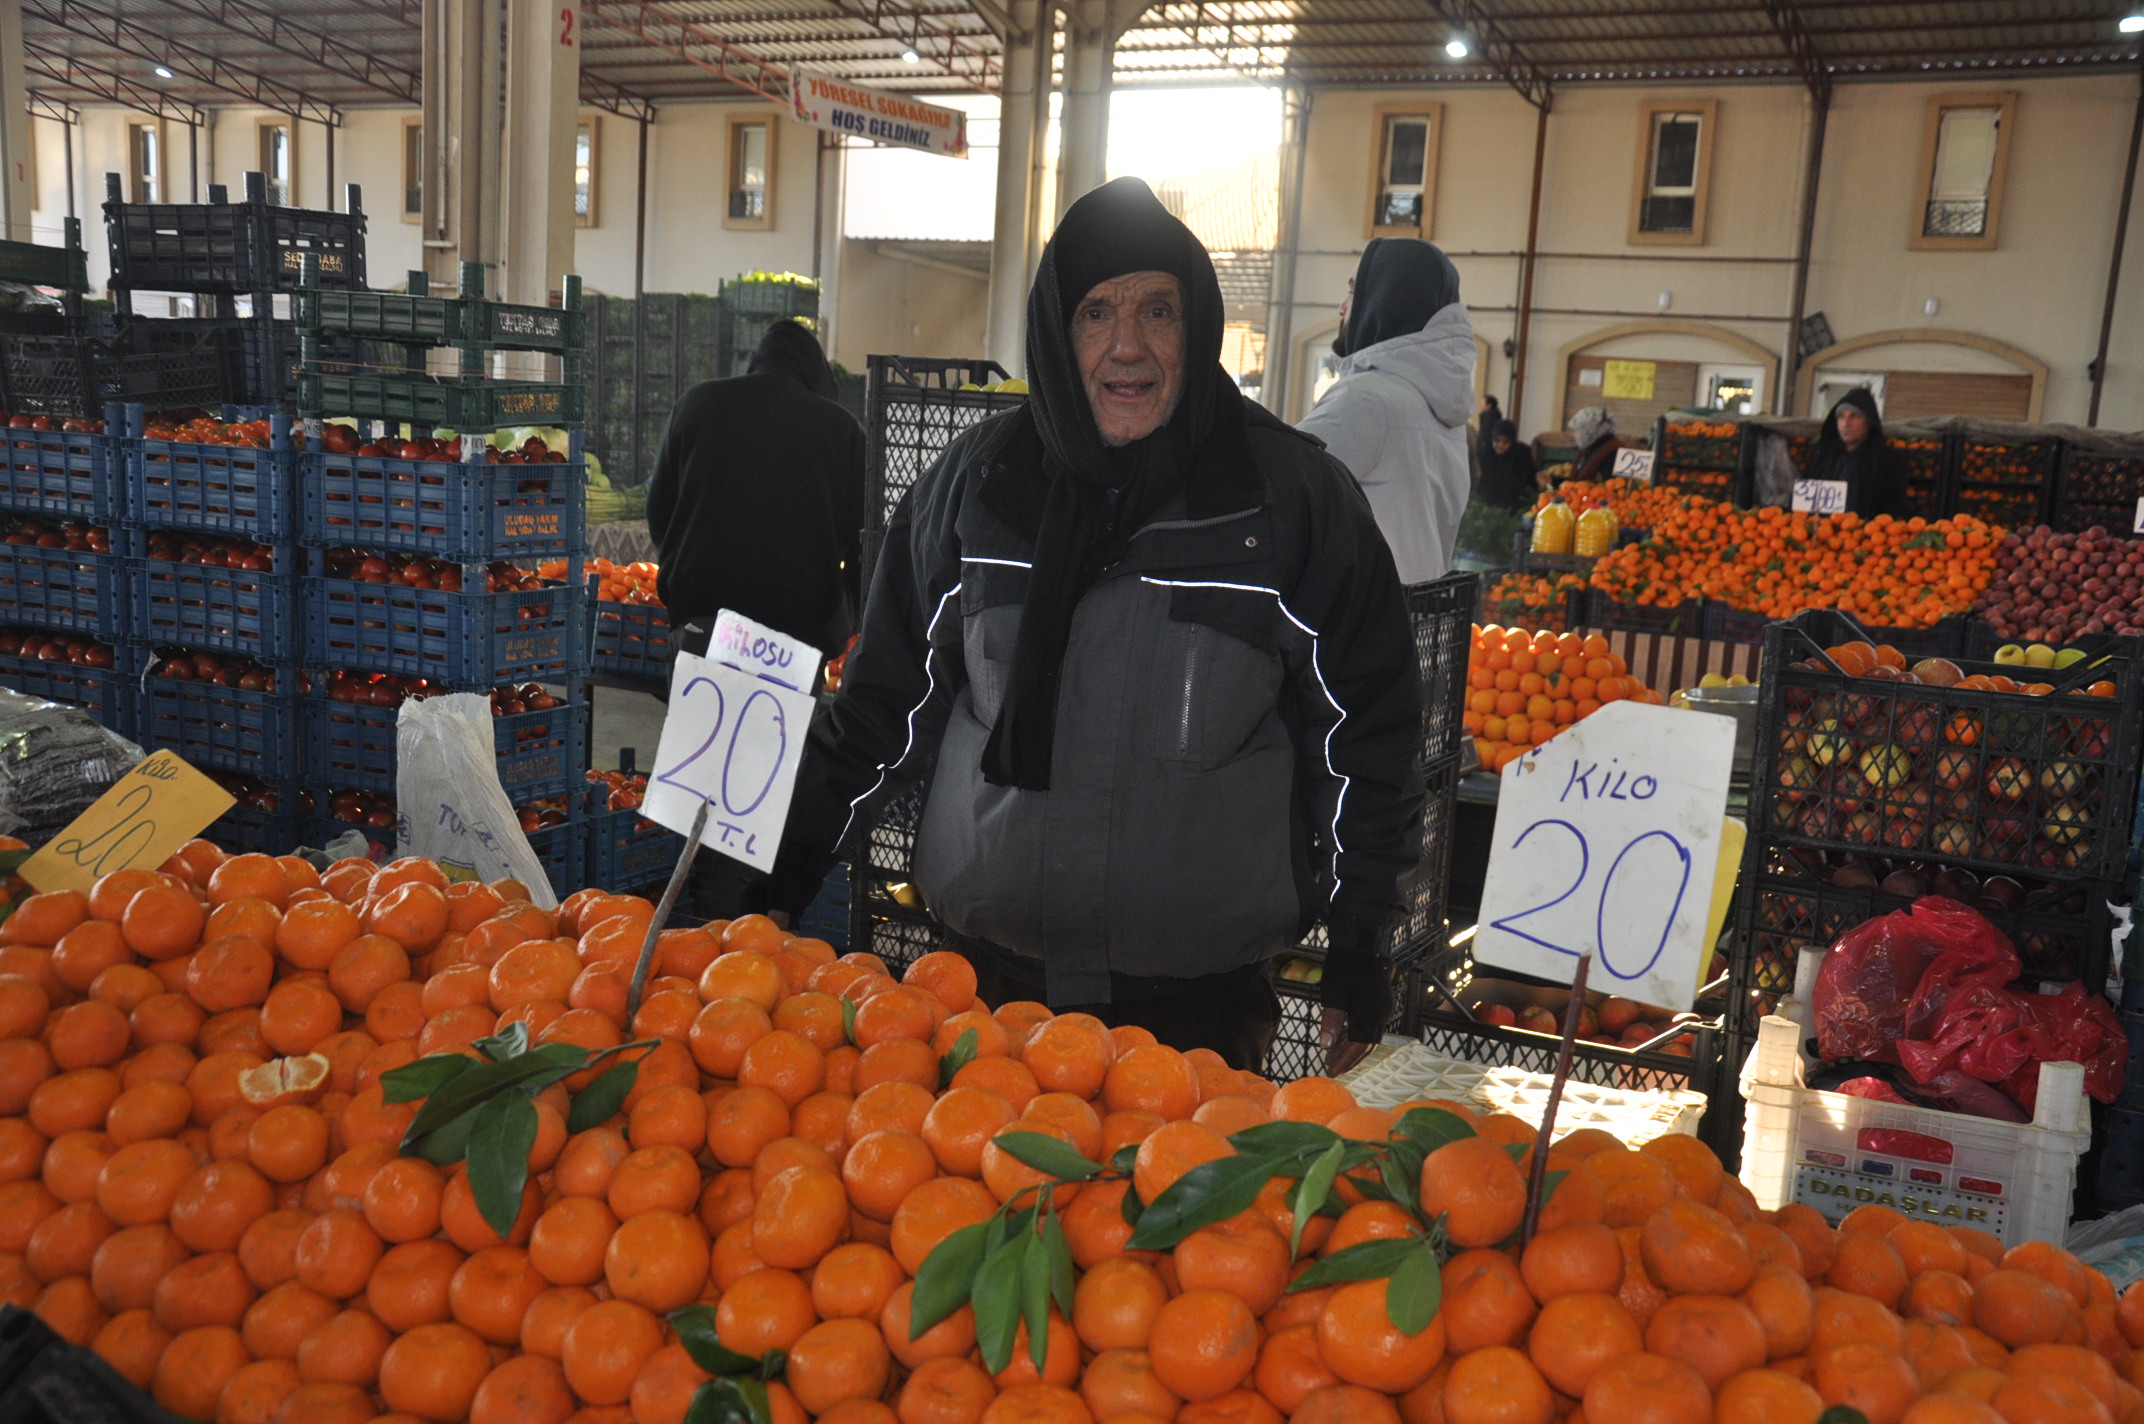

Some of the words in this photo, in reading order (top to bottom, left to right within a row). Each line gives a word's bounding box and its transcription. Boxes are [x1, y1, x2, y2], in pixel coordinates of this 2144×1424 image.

[560, 7, 574, 47] 2
[831, 108, 866, 134] HOŞ
[869, 118, 930, 147] GELDİNİZ
[656, 676, 787, 817] 20
[55, 784, 156, 879] 20
[1489, 818, 1692, 980] 20
[1810, 1178, 1989, 1224] DADAŞLAR
